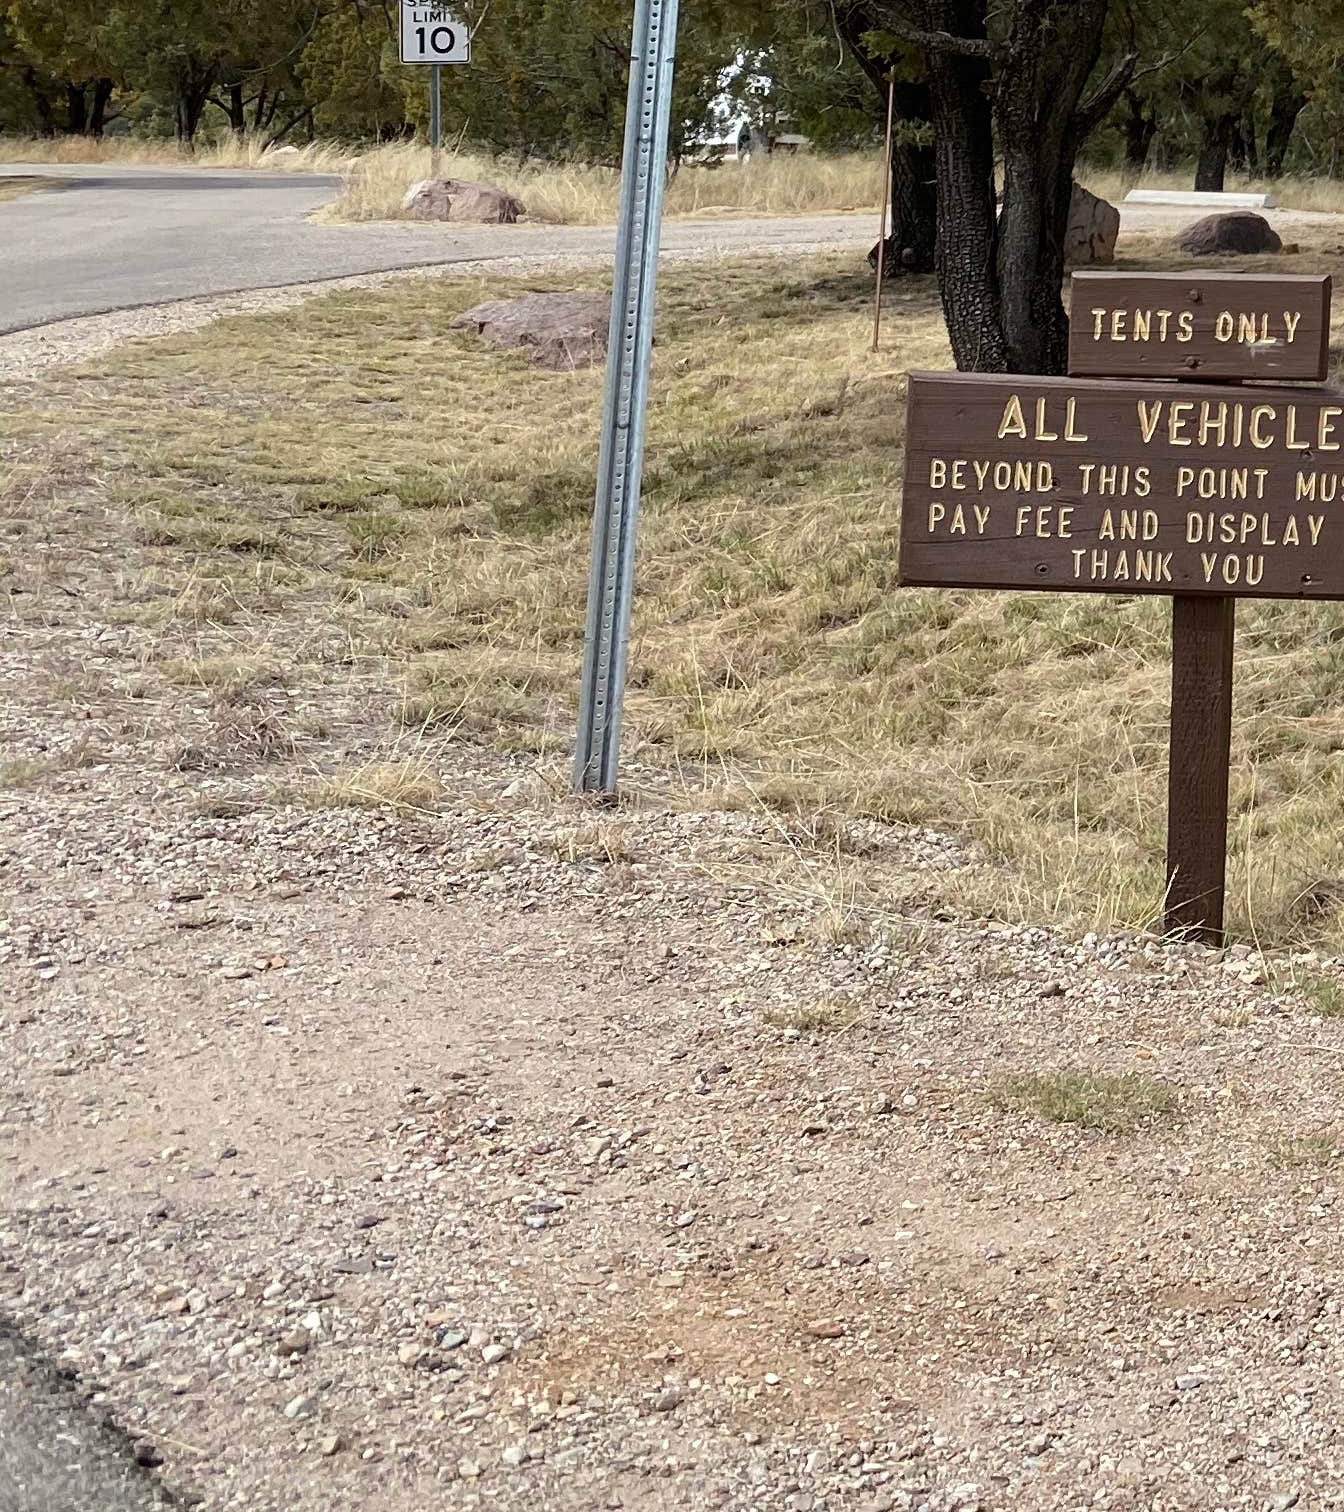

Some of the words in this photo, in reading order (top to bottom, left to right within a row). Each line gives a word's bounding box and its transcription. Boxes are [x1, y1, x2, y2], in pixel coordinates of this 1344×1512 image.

[416, 26, 455, 54] 10
[1091, 308, 1194, 343] TENTS
[1215, 311, 1301, 345] ONLY
[998, 394, 1089, 443] ALL
[929, 458, 1054, 493] BEYOND
[1079, 464, 1151, 497] THIS
[1177, 467, 1269, 501] POINT
[928, 503, 991, 536] PAY
[1015, 506, 1075, 539] FEE
[1099, 509, 1159, 542] AND
[1186, 512, 1327, 547] DISPLAY
[1072, 549, 1173, 583] THANK
[1201, 554, 1266, 586] YOU
